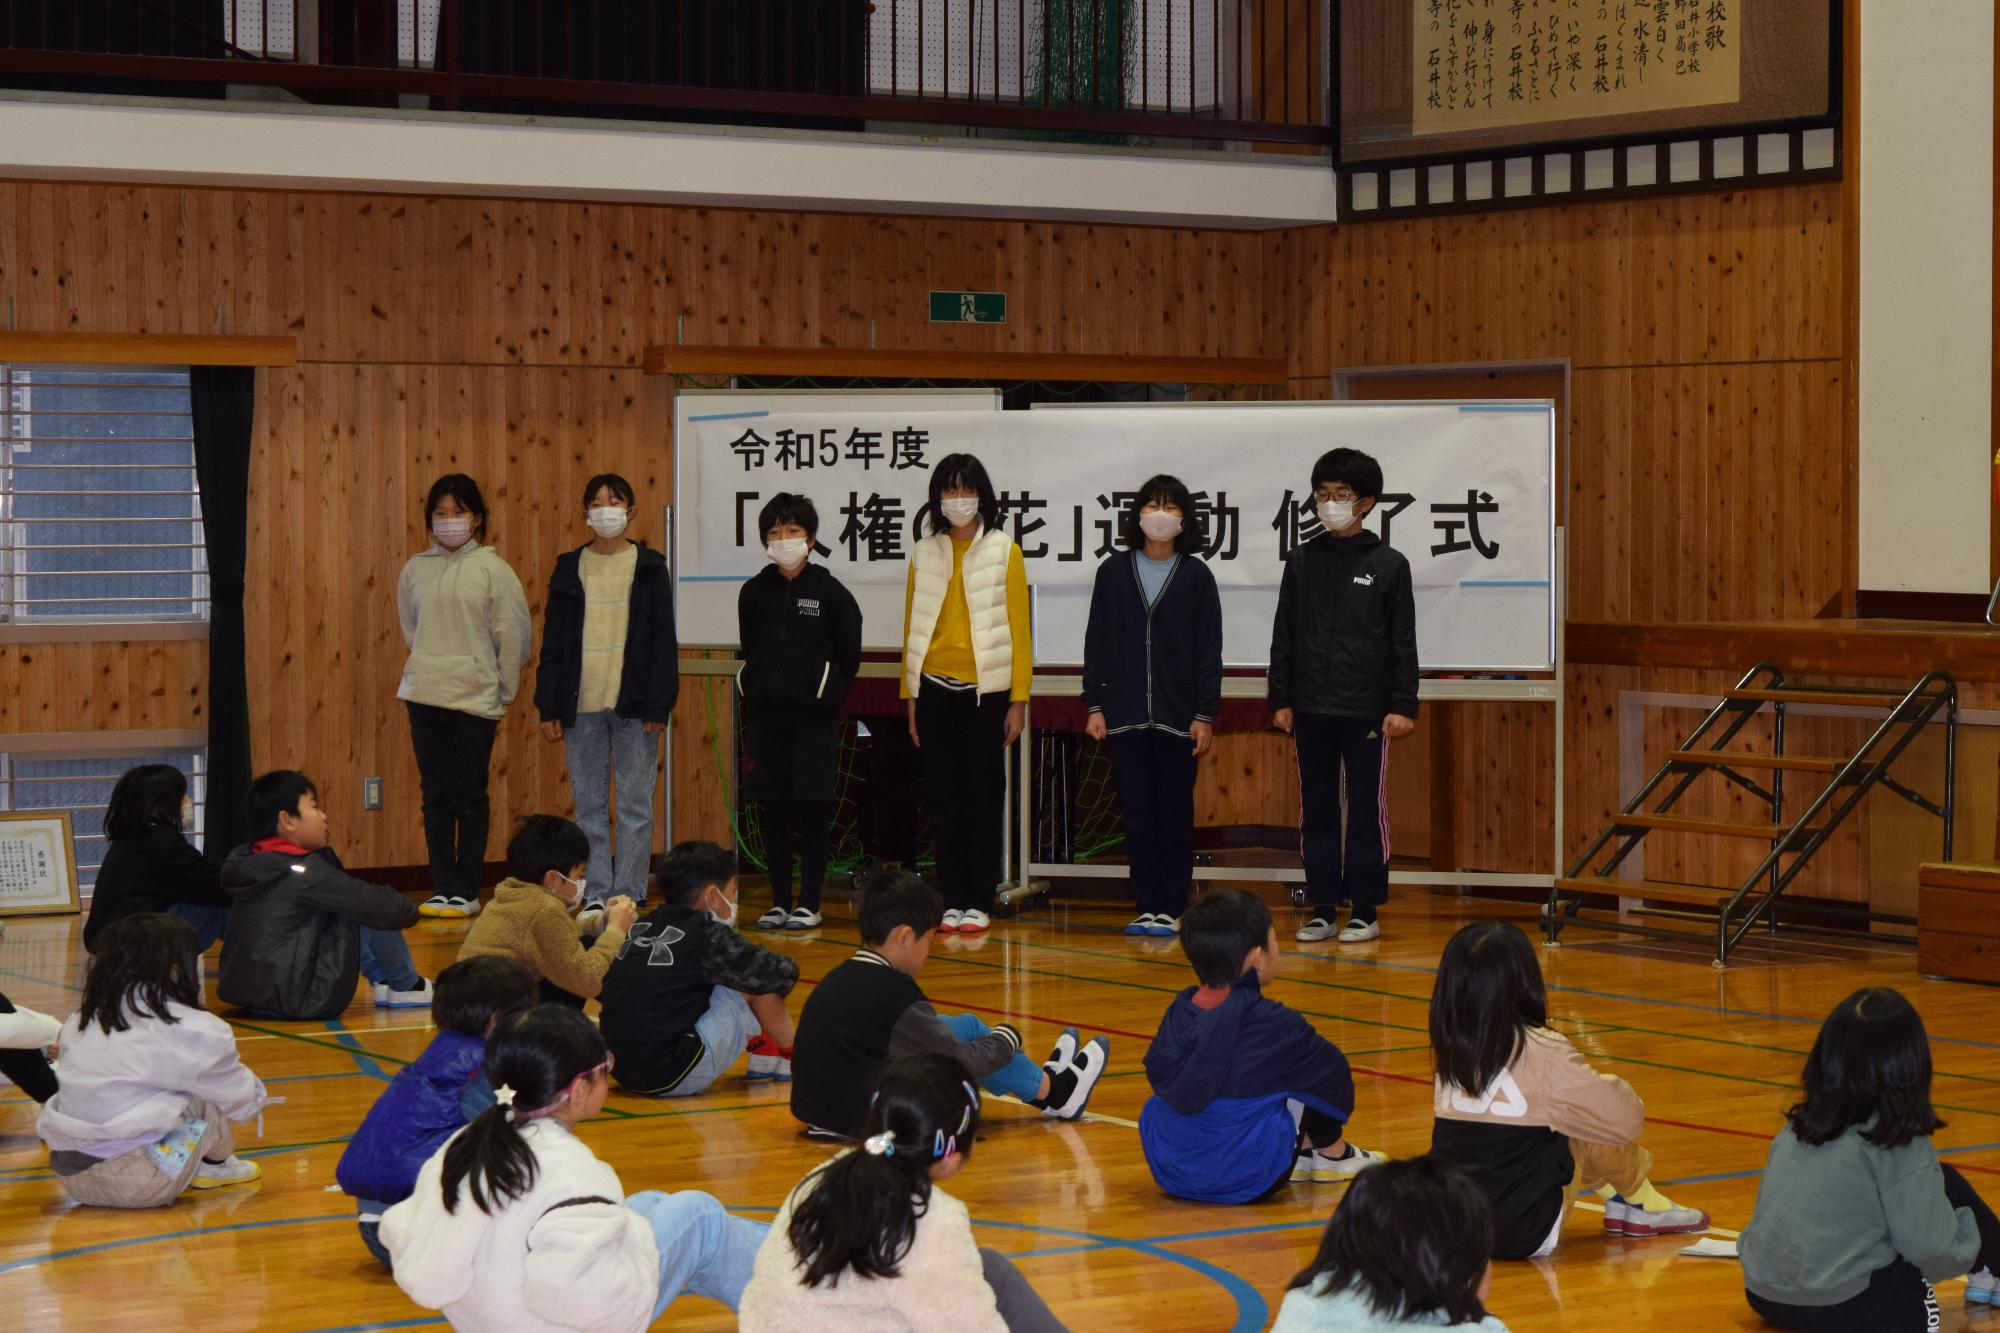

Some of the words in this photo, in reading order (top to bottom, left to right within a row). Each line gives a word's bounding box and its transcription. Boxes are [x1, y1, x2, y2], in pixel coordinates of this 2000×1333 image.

[730, 426, 929, 471] 令和5年度
[736, 491, 1239, 562] 「権花」運動
